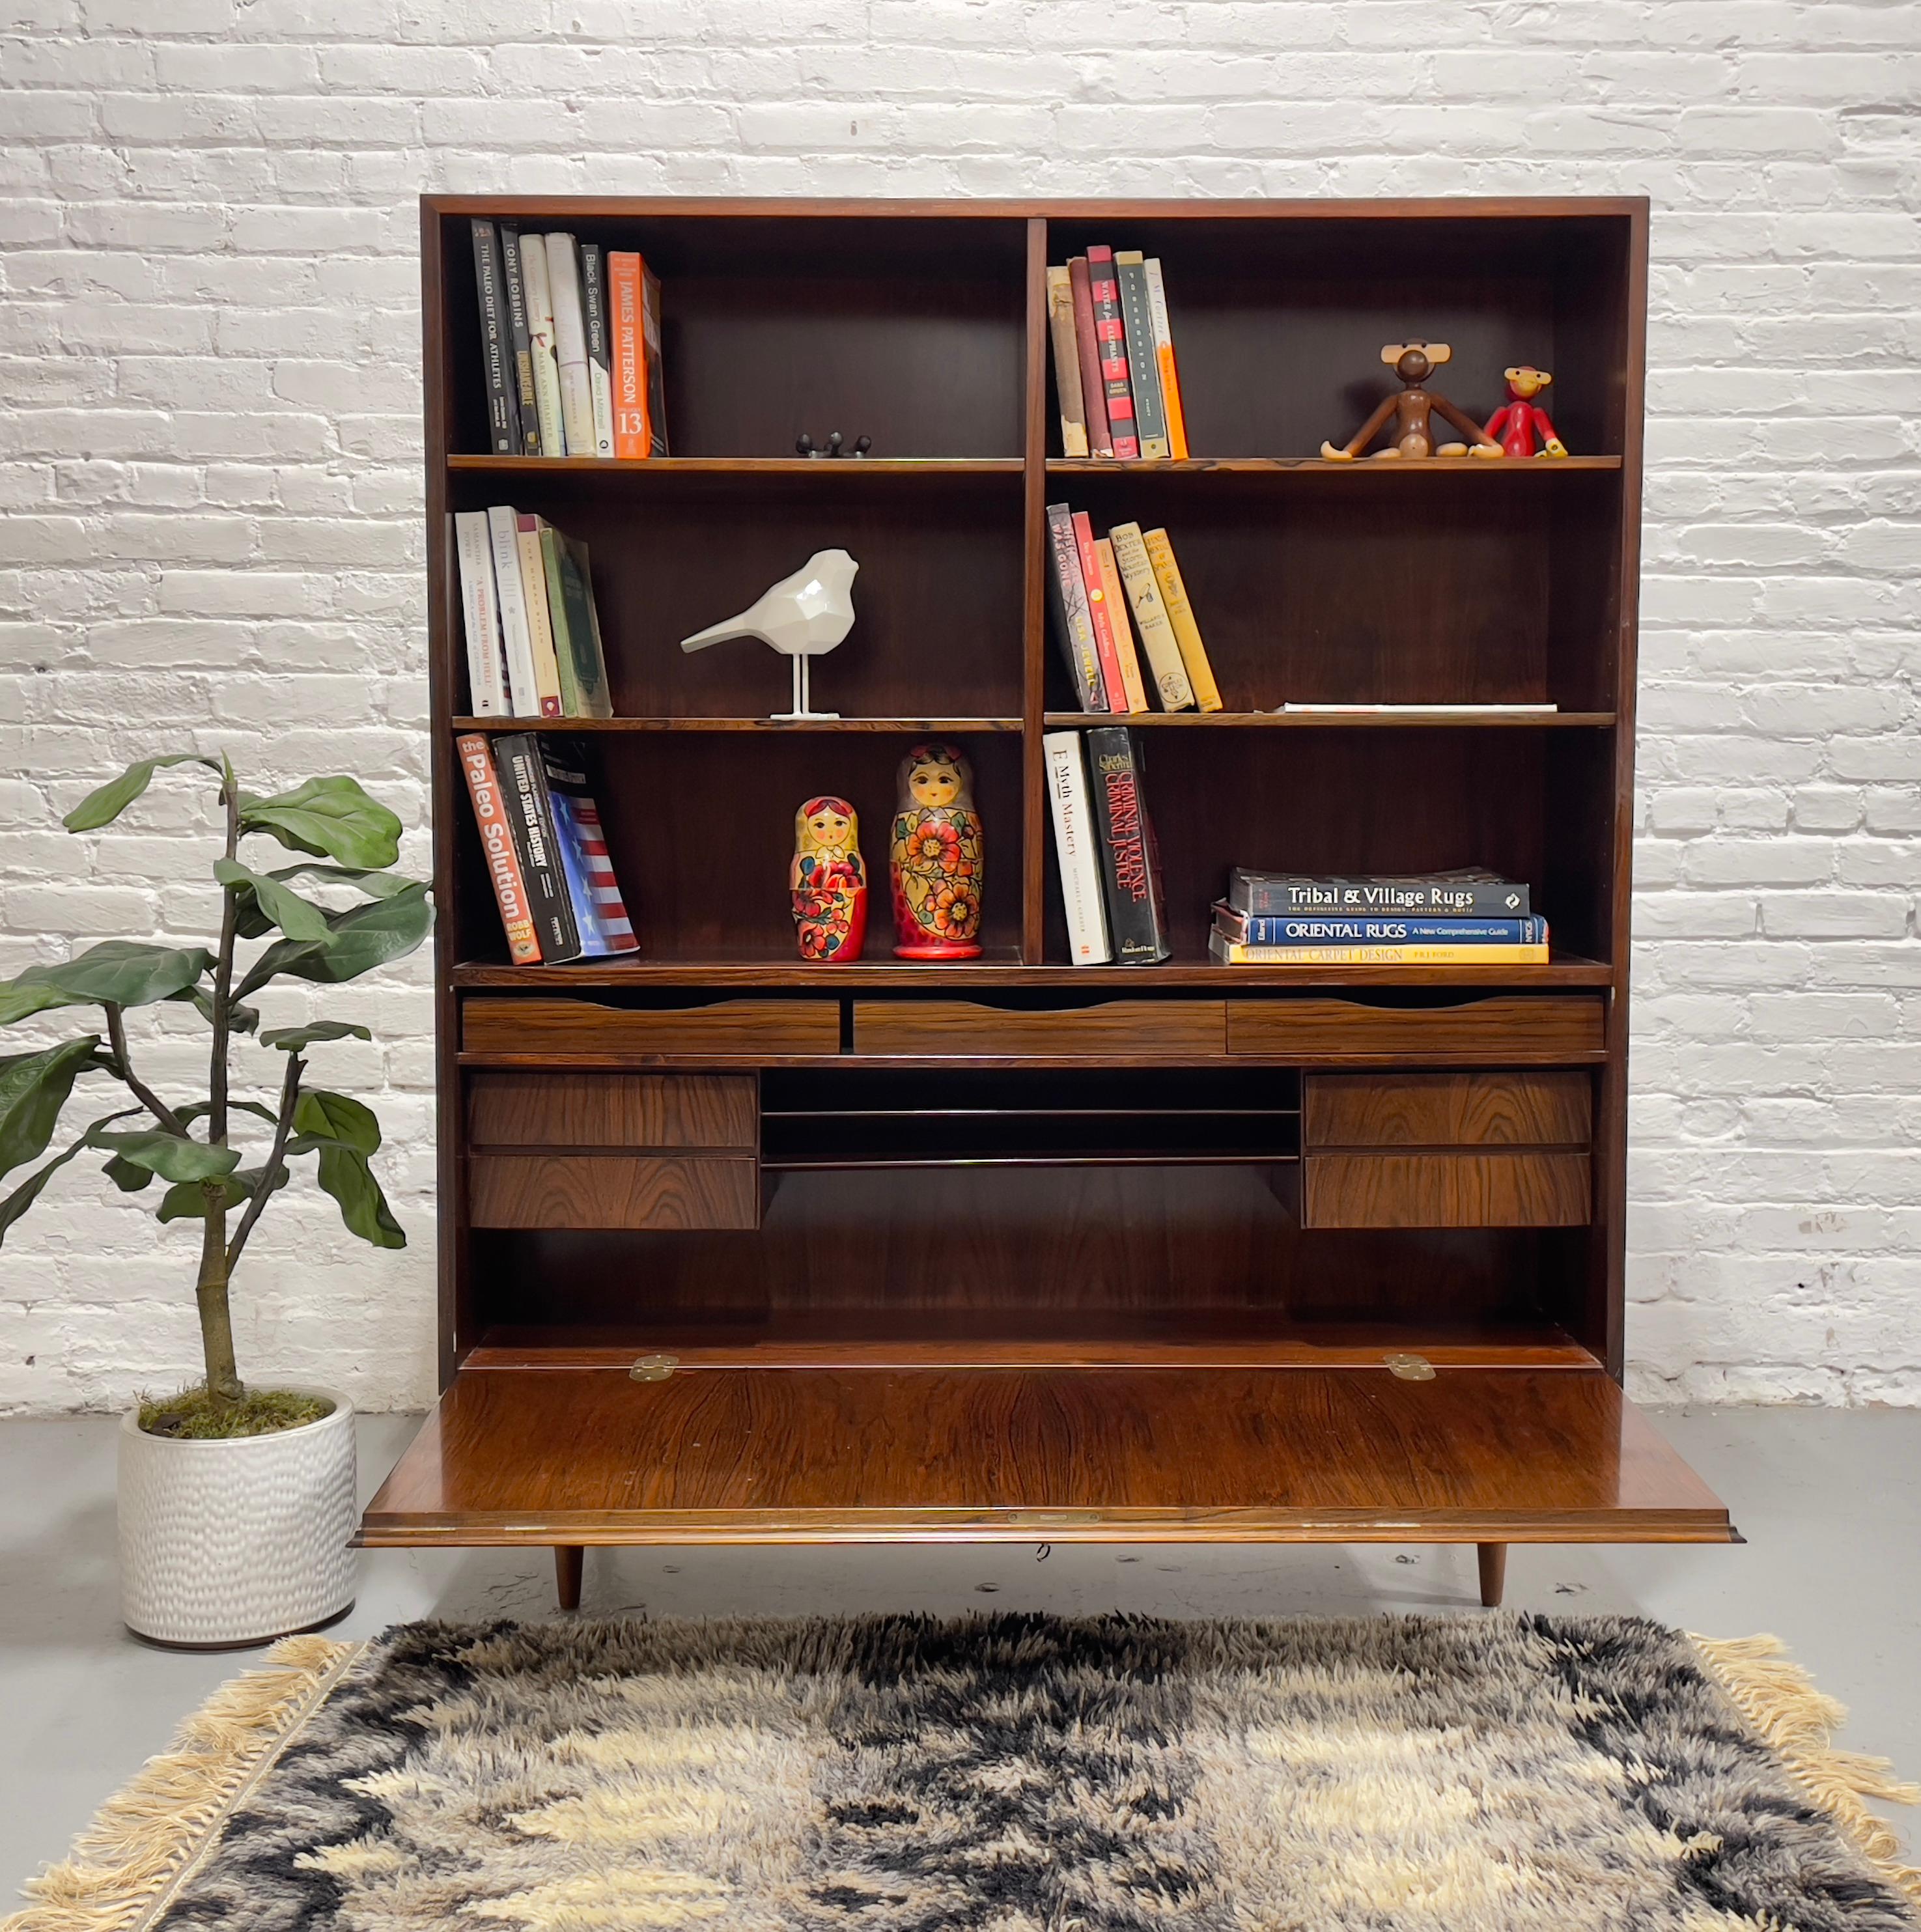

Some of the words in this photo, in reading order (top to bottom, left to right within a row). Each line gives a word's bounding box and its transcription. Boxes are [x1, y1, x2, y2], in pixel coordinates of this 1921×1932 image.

[481, 244, 490, 263] THE
[506, 243, 518, 273] TONY
[586, 254, 597, 284] Black
[483, 266, 493, 294] PALEO
[484, 296, 495, 321] DIET
[510, 277, 524, 328] ROBBINS
[588, 287, 598, 316] Swan
[619, 281, 634, 323] JAMES
[488, 320, 498, 341] FOR
[590, 320, 600, 352] Green
[1101, 281, 1112, 309] WATER
[1107, 325, 1119, 372] ELEPHANTS
[490, 343, 501, 389] ATHLETES
[516, 350, 534, 406] UNSHAKEABLE
[537, 351, 546, 377] MARY
[621, 327, 636, 403] PATTERSON
[596, 398, 605, 430] Mitchell
[620, 413, 642, 434] 13
[463, 531, 472, 559] POWER
[472, 522, 483, 566] SAMANTHA
[498, 530, 512, 570] blink
[1052, 524, 1065, 549] WAS
[1058, 554, 1071, 587] GONE
[529, 568, 539, 606] HUMAN
[477, 588, 488, 631] PROBLEM
[481, 634, 489, 659] FROM
[1075, 617, 1087, 641] LISA
[1081, 644, 1095, 687] JEWELL
[1101, 629, 1110, 658] Goldberg
[462, 739, 484, 753] the
[1053, 749, 1068, 761] E
[512, 755, 529, 792] UNITED
[1060, 766, 1073, 798] Myth
[520, 793, 537, 826] STATES
[1105, 773, 1126, 838] CRIMINAL
[1119, 772, 1140, 836] CRIMINAL
[466, 753, 494, 818] Paleo
[484, 822, 520, 919] Solution
[527, 826, 548, 867] HISTORY
[1063, 804, 1076, 857] Mastery
[1107, 837, 1131, 889] JUSTICE
[1288, 887, 1338, 904] Tribal
[1343, 889, 1361, 904] &
[1364, 887, 1425, 907] Village
[1431, 888, 1474, 908] Rugs
[507, 919, 529, 932] ROBB
[508, 928, 531, 941] WOLF
[1285, 923, 1362, 938] ORIENTAL
[1366, 923, 1407, 938] RUGS
[1412, 927, 1419, 935] A
[1436, 927, 1487, 936] Comprehensive
[1488, 927, 1508, 936] Guide
[1246, 947, 1302, 961] ORIENTAL
[1309, 947, 1355, 961] CARPET
[1360, 947, 1403, 961] DESIGN
